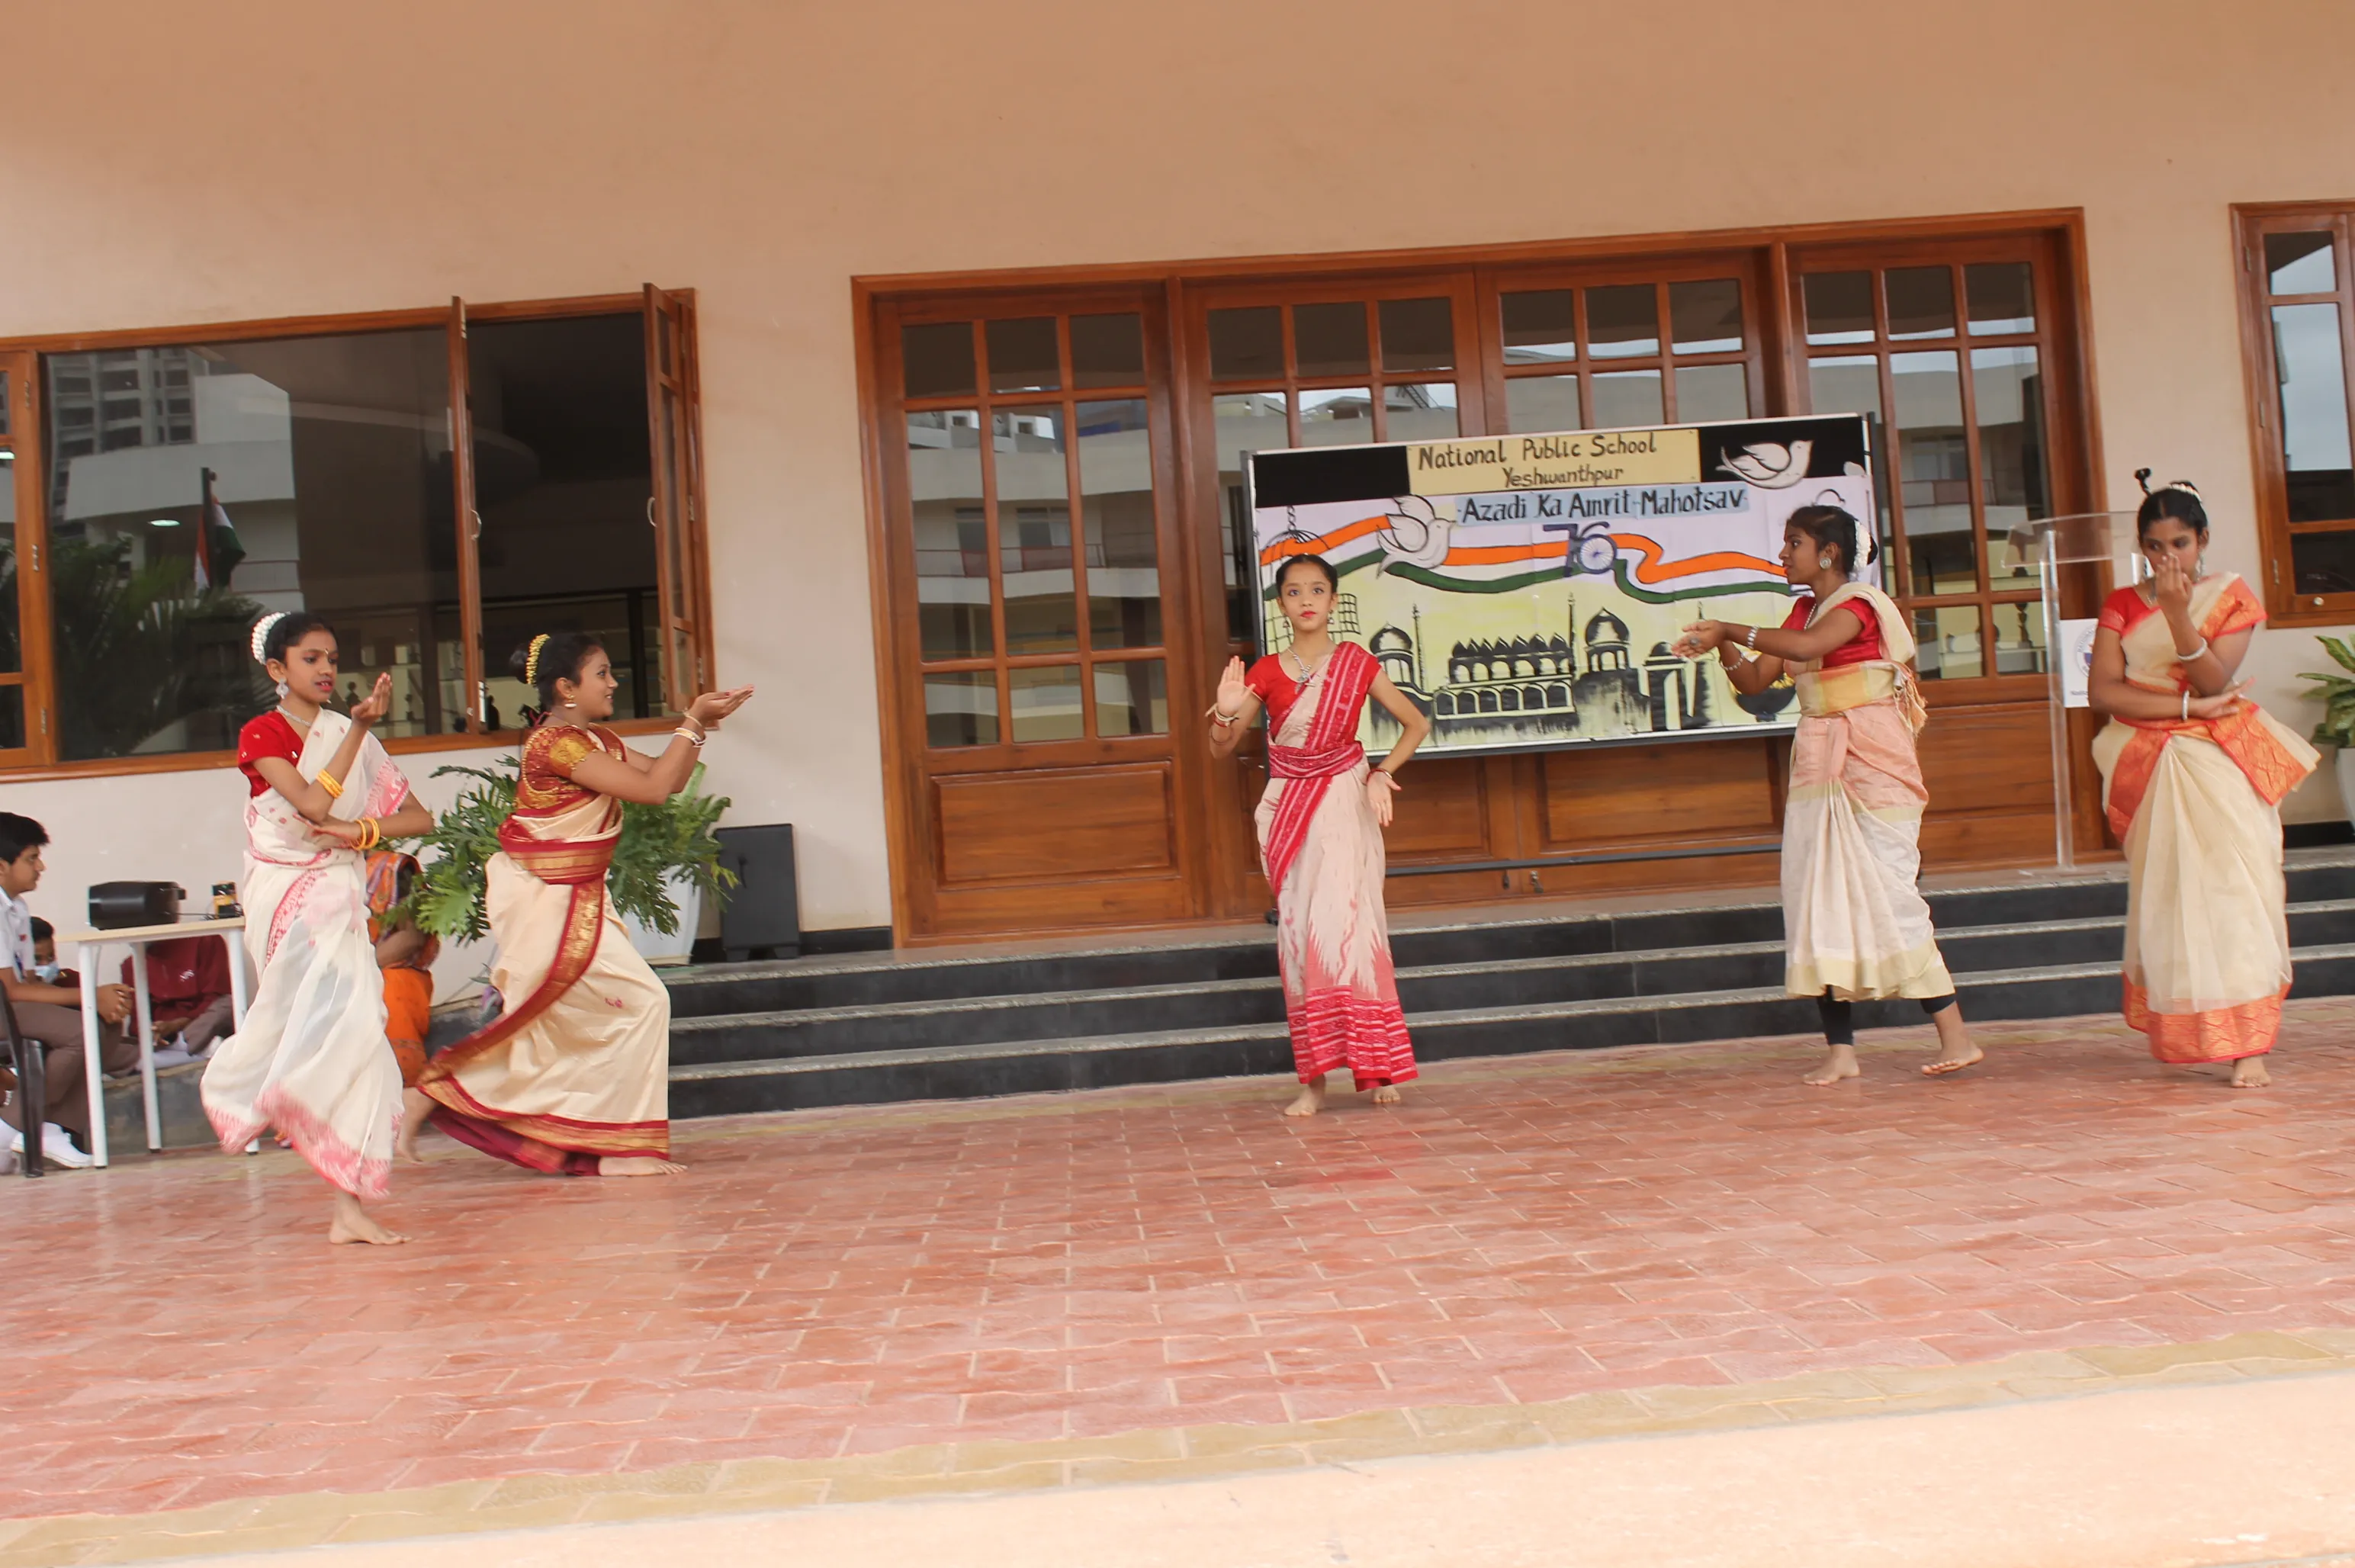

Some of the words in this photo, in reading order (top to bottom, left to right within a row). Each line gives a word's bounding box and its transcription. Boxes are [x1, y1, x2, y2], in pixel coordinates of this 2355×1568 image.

[1418, 439, 1507, 471] National
[1522, 439, 1582, 461] Public
[1590, 432, 1657, 458] School
[1502, 464, 1624, 488] Yeshwanthpur
[1461, 494, 1527, 523] Azadi
[1535, 493, 1563, 517] Ka
[1543, 522, 1618, 577] 76
